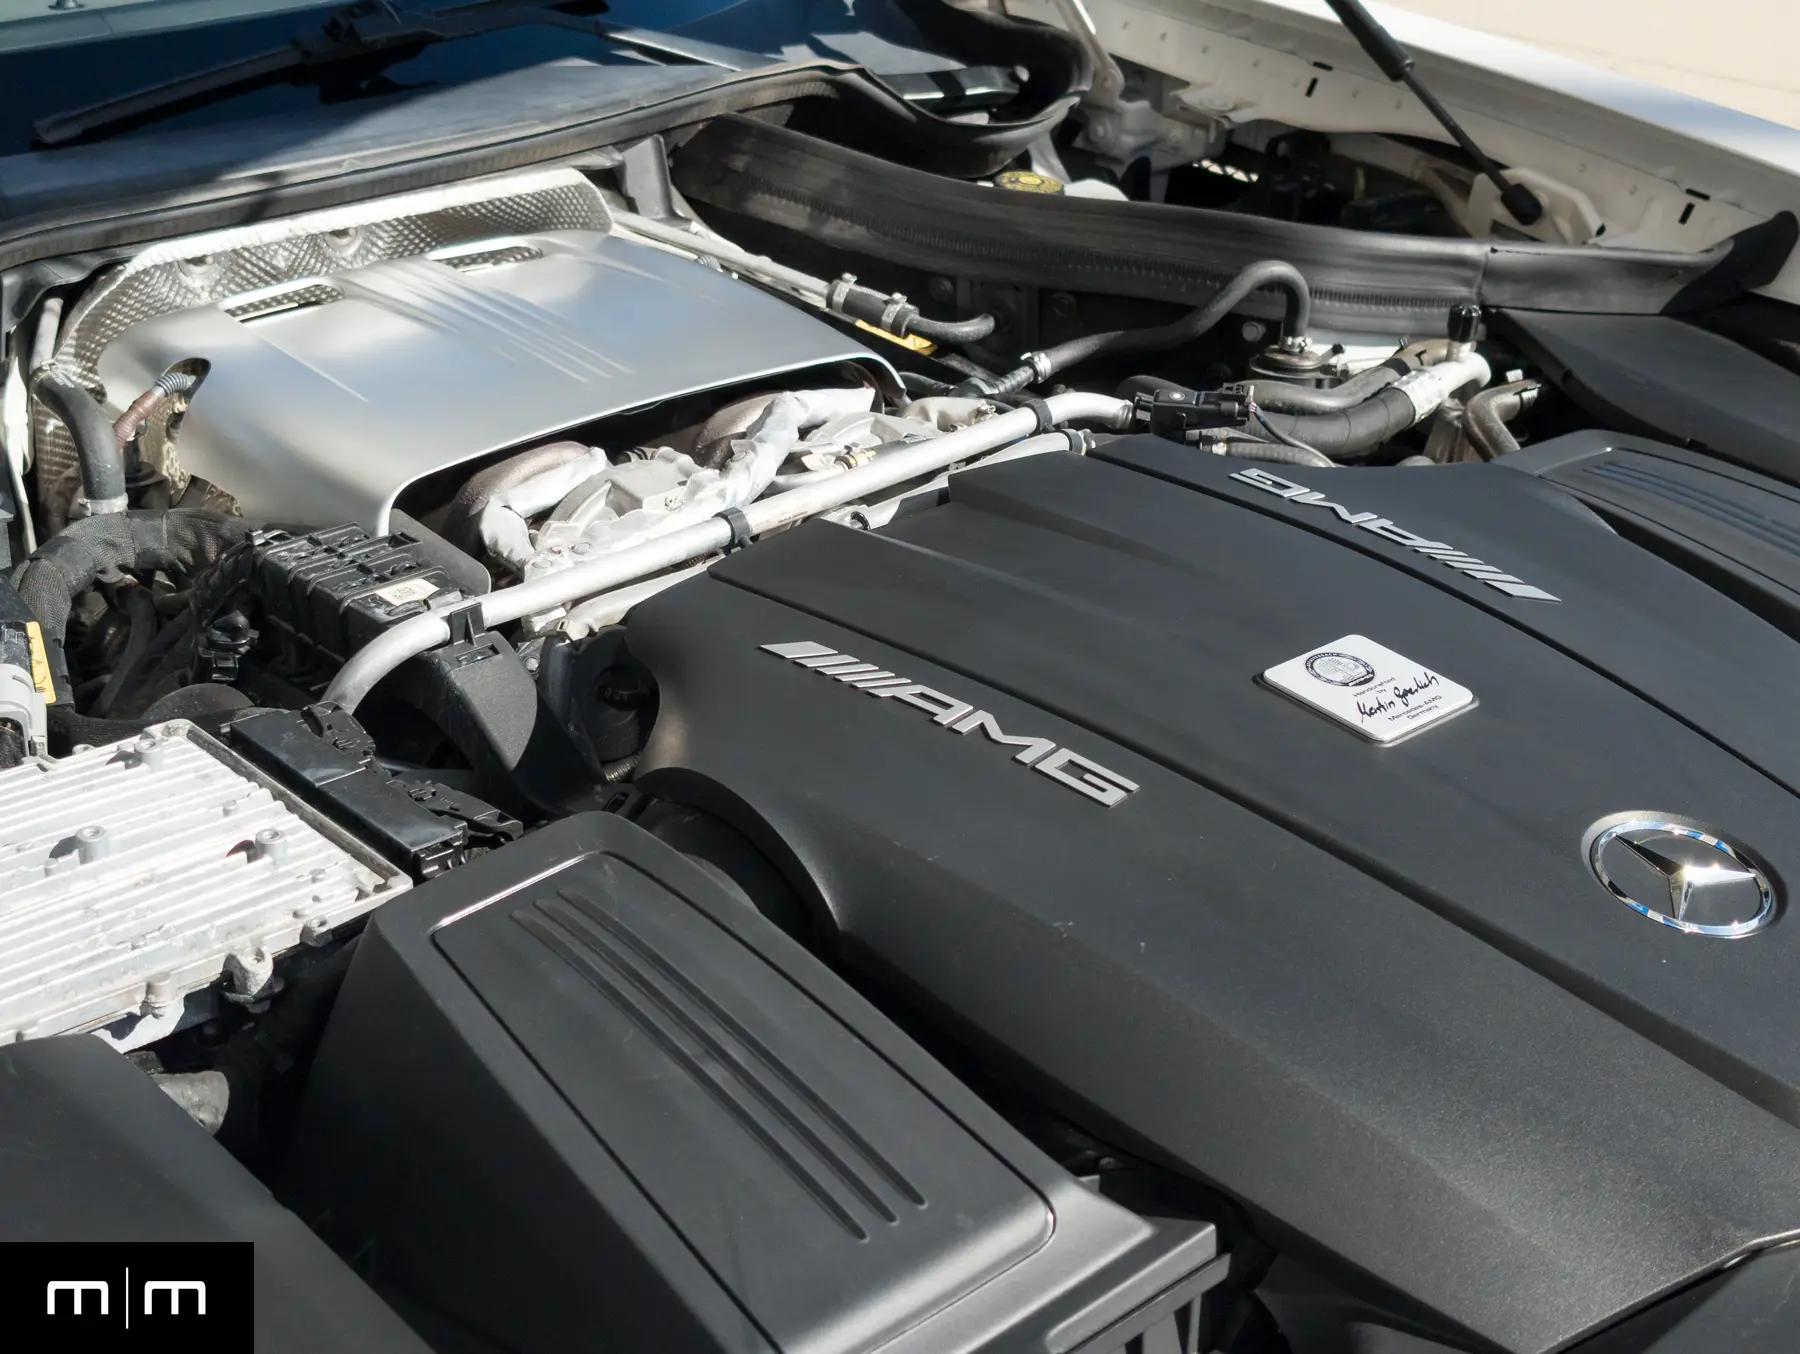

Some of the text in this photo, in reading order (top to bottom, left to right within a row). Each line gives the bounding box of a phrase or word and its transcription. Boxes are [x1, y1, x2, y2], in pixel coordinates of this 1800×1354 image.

[1229, 468, 1453, 549] AMG
[1388, 695, 1443, 721] Mercedes-AMG
[1407, 704, 1439, 720] Germany
[866, 684, 1140, 807] AMG
